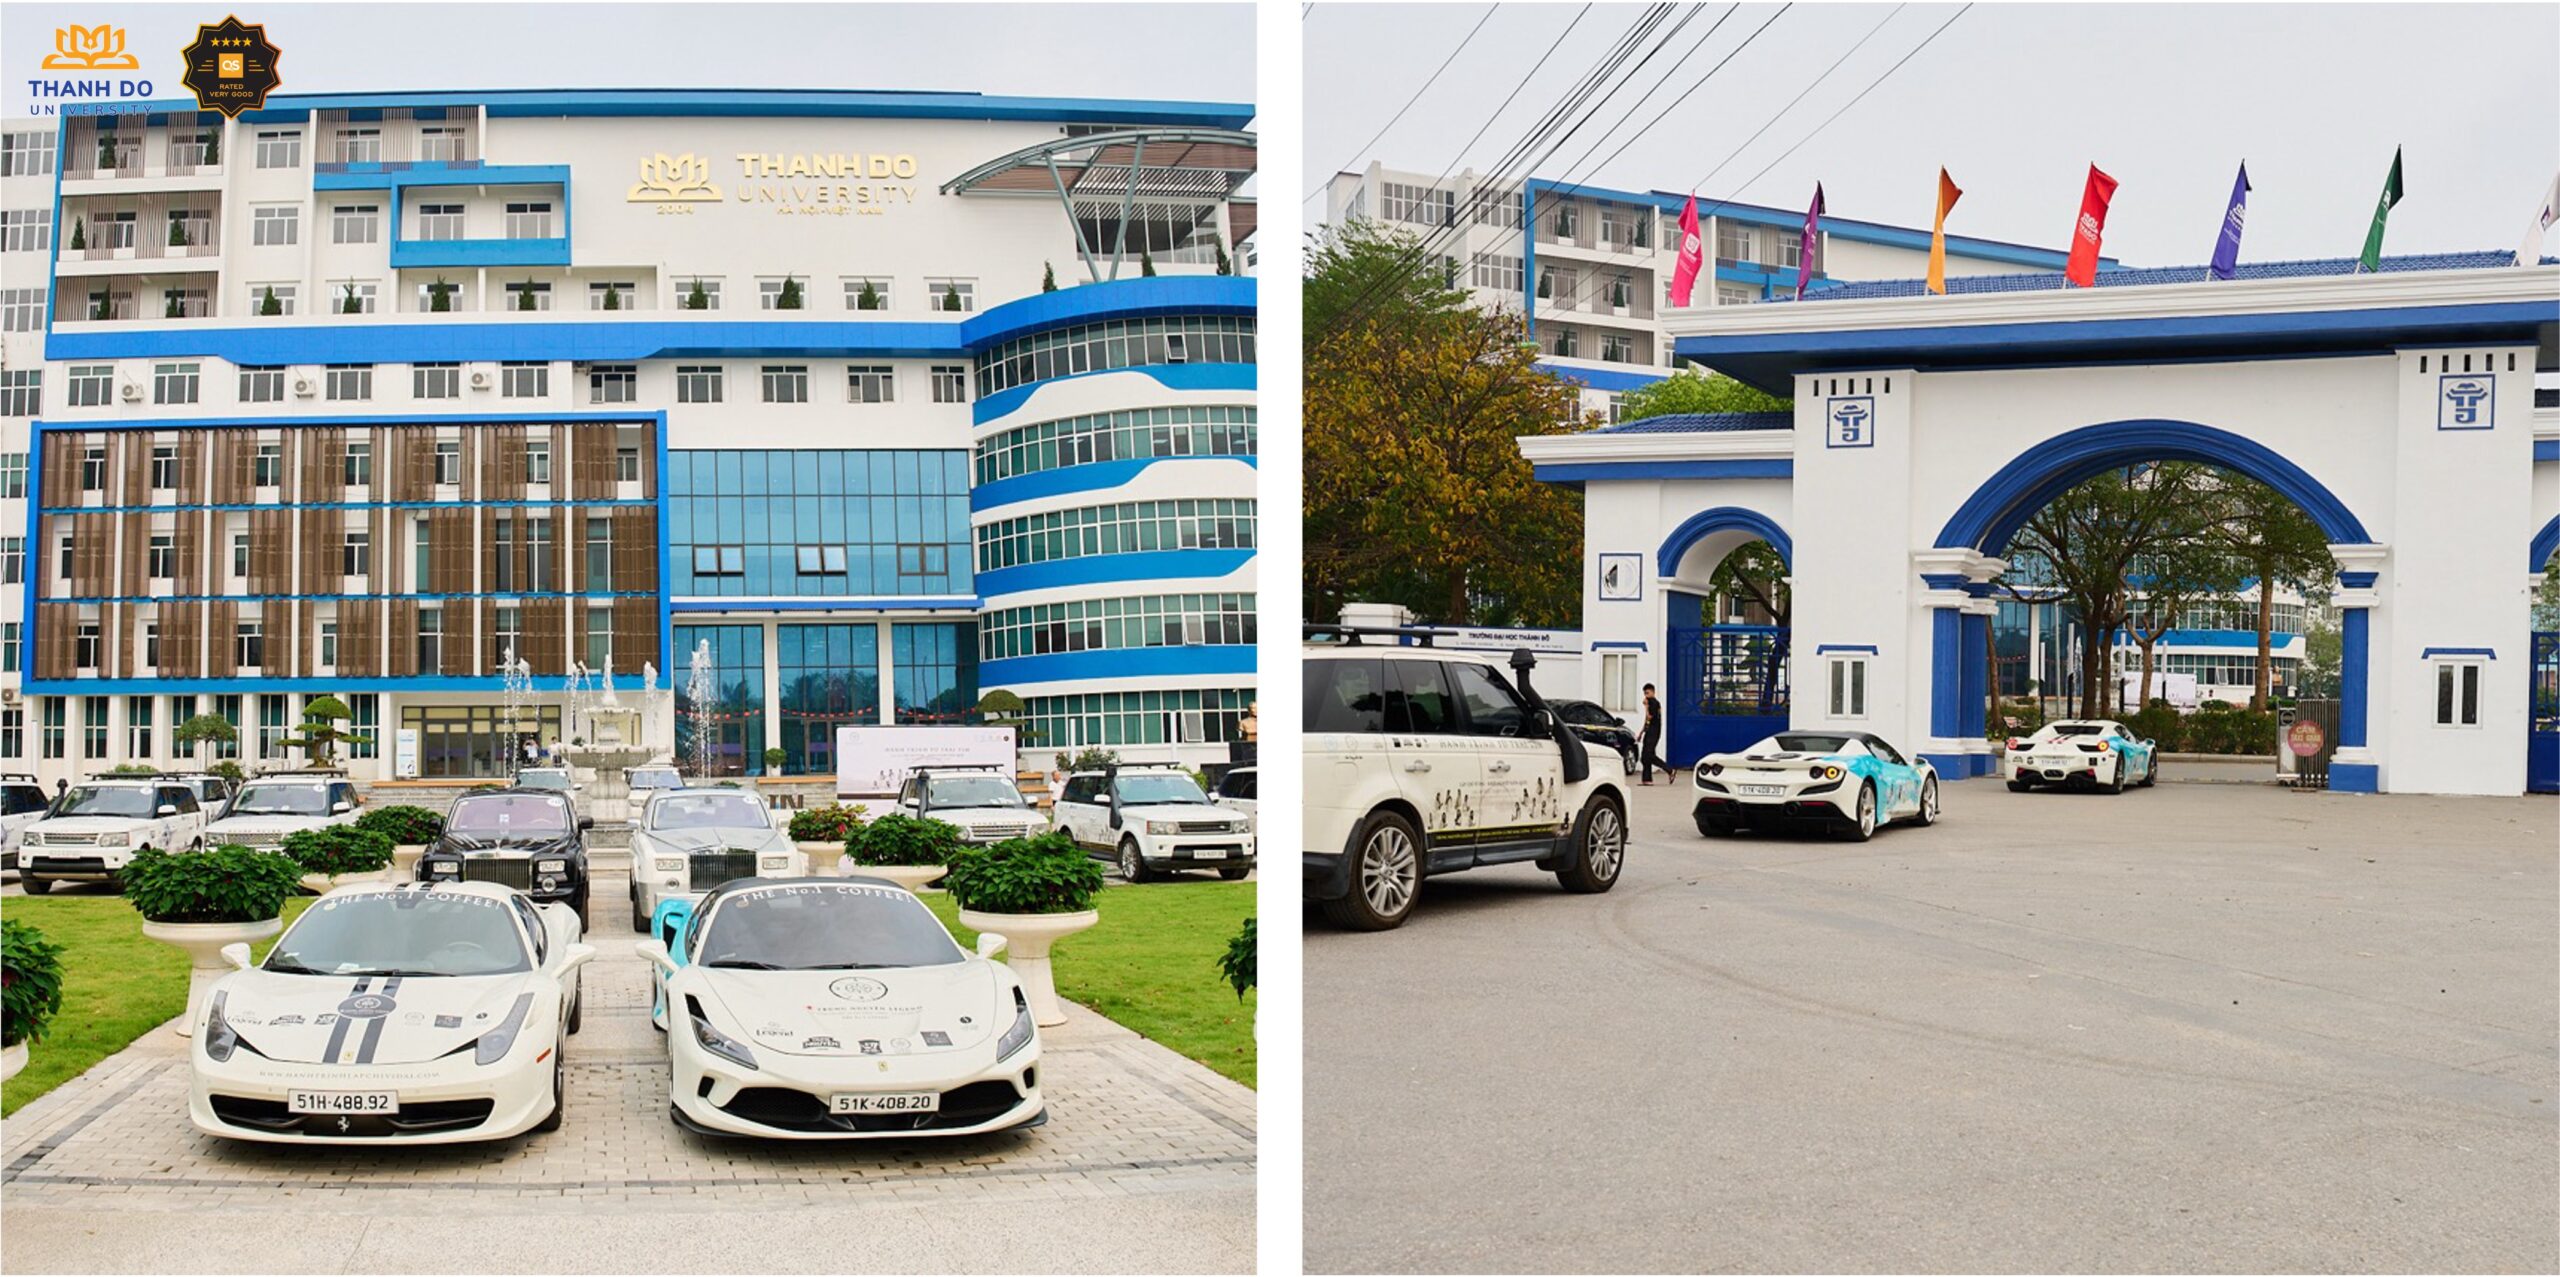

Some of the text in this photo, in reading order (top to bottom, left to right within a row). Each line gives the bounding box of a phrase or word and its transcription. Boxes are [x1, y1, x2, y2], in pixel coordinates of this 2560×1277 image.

[736, 152, 918, 179] THANH DO
[737, 184, 918, 203] UNIVERSITY
[656, 203, 694, 215] 2004
[330, 893, 363, 905] THE
[373, 891, 413, 900] No.1
[739, 889, 776, 905] THE
[785, 886, 824, 896] No.1
[297, 1093, 388, 1110] 51H-488.92
[840, 1096, 931, 1110] 51K-408.20
